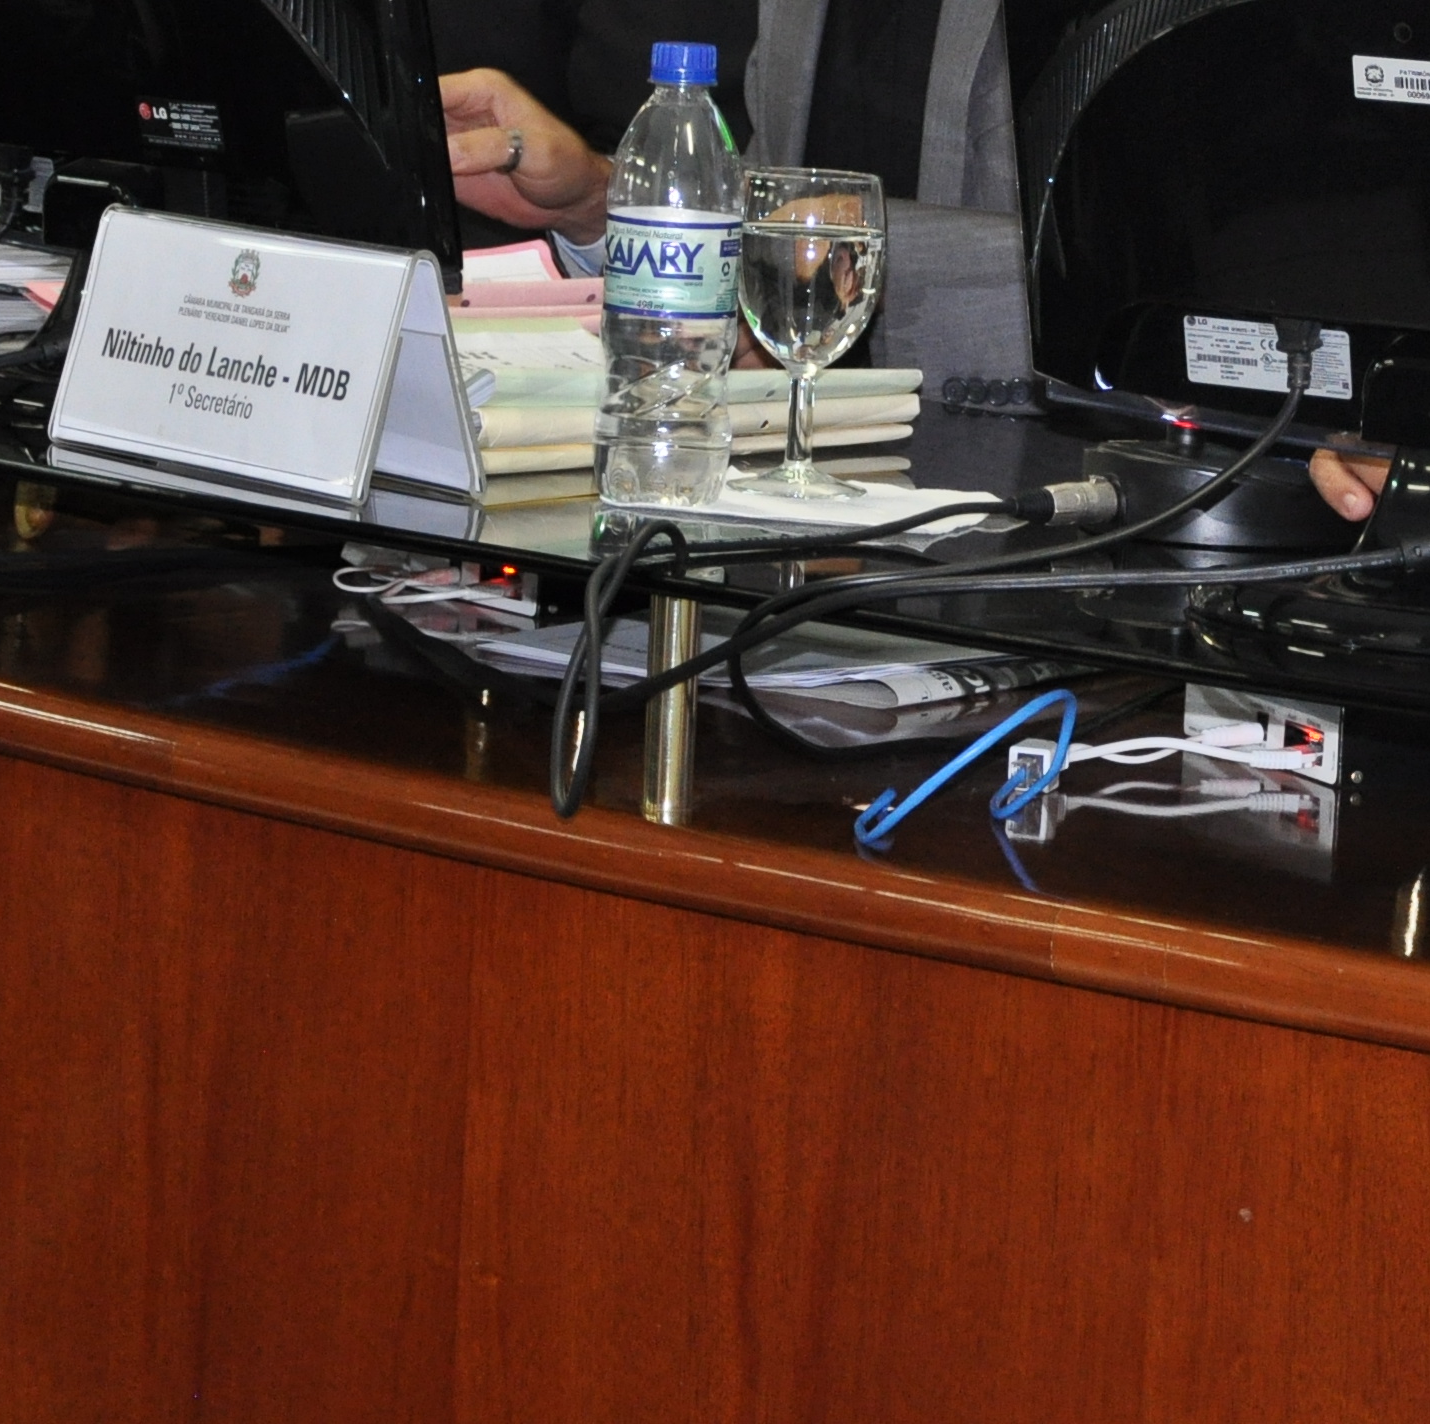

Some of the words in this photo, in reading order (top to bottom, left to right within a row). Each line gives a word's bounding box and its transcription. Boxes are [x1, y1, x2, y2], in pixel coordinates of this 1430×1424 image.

[152, 106, 168, 120] LG
[1197, 318, 1208, 326] LG
[101, 327, 175, 369] Niltinho
[178, 342, 202, 374] do
[206, 346, 277, 388] Lanche
[295, 362, 351, 401] MDB
[184, 386, 253, 420] Secretário
